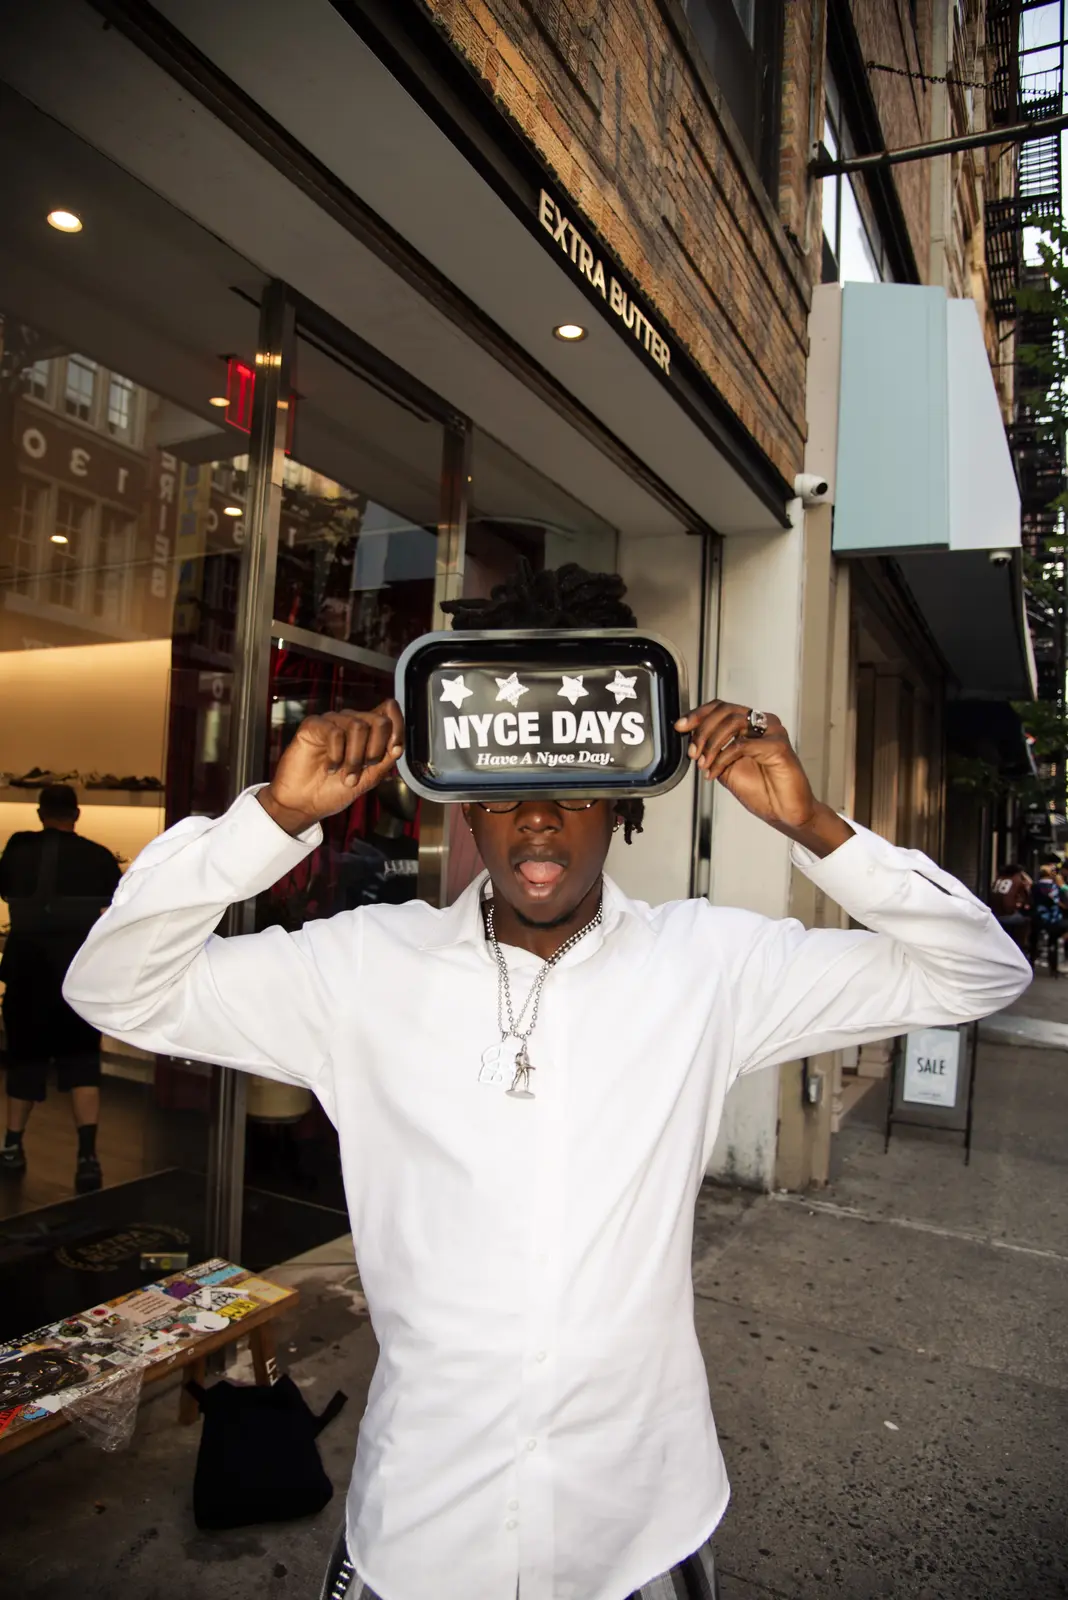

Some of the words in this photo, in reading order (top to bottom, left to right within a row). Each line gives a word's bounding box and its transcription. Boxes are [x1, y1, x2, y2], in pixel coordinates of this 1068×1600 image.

[539, 188, 607, 300] EXTRA
[609, 277, 671, 376] BUTTER
[443, 711, 541, 750] NYCE
[553, 711, 646, 746] DAYS
[476, 751, 518, 766] Have
[520, 753, 532, 765] A
[536, 751, 576, 767] Nyce
[578, 750, 615, 766] Day.
[917, 1057, 946, 1075] SALE
